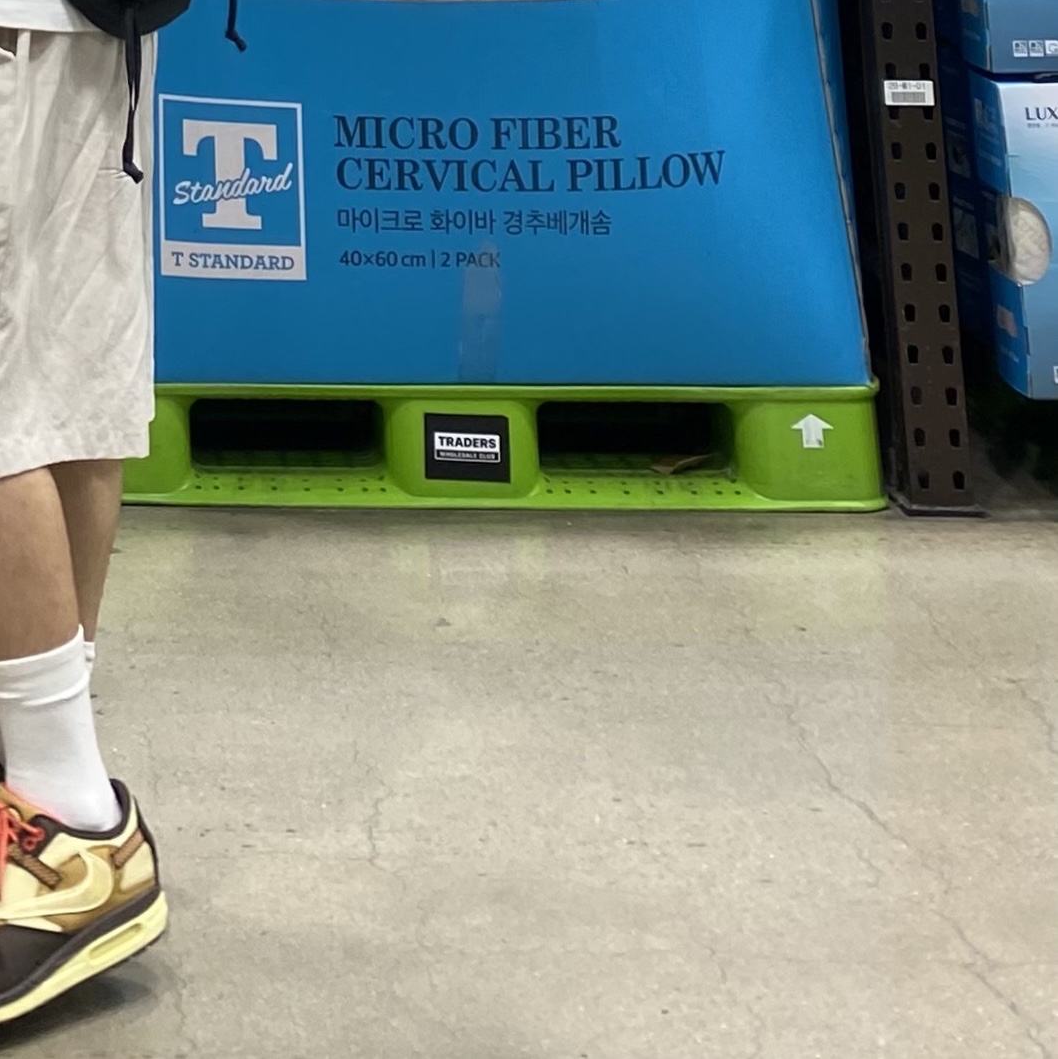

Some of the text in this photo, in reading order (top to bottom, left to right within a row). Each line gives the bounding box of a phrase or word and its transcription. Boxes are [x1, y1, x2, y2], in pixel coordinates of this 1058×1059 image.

[333, 114, 622, 151] MICRO FIBER
[172, 161, 293, 207] Standard
[182, 119, 278, 231] T
[335, 150, 726, 194] CERVICAL PILLOW
[336, 208, 612, 236] 마이크로 화이바 경추베개솜
[171, 250, 296, 272] T STANDARD
[440, 251, 451, 269] 2
[455, 251, 502, 270] PACK
[438, 436, 497, 449] TRADERS
